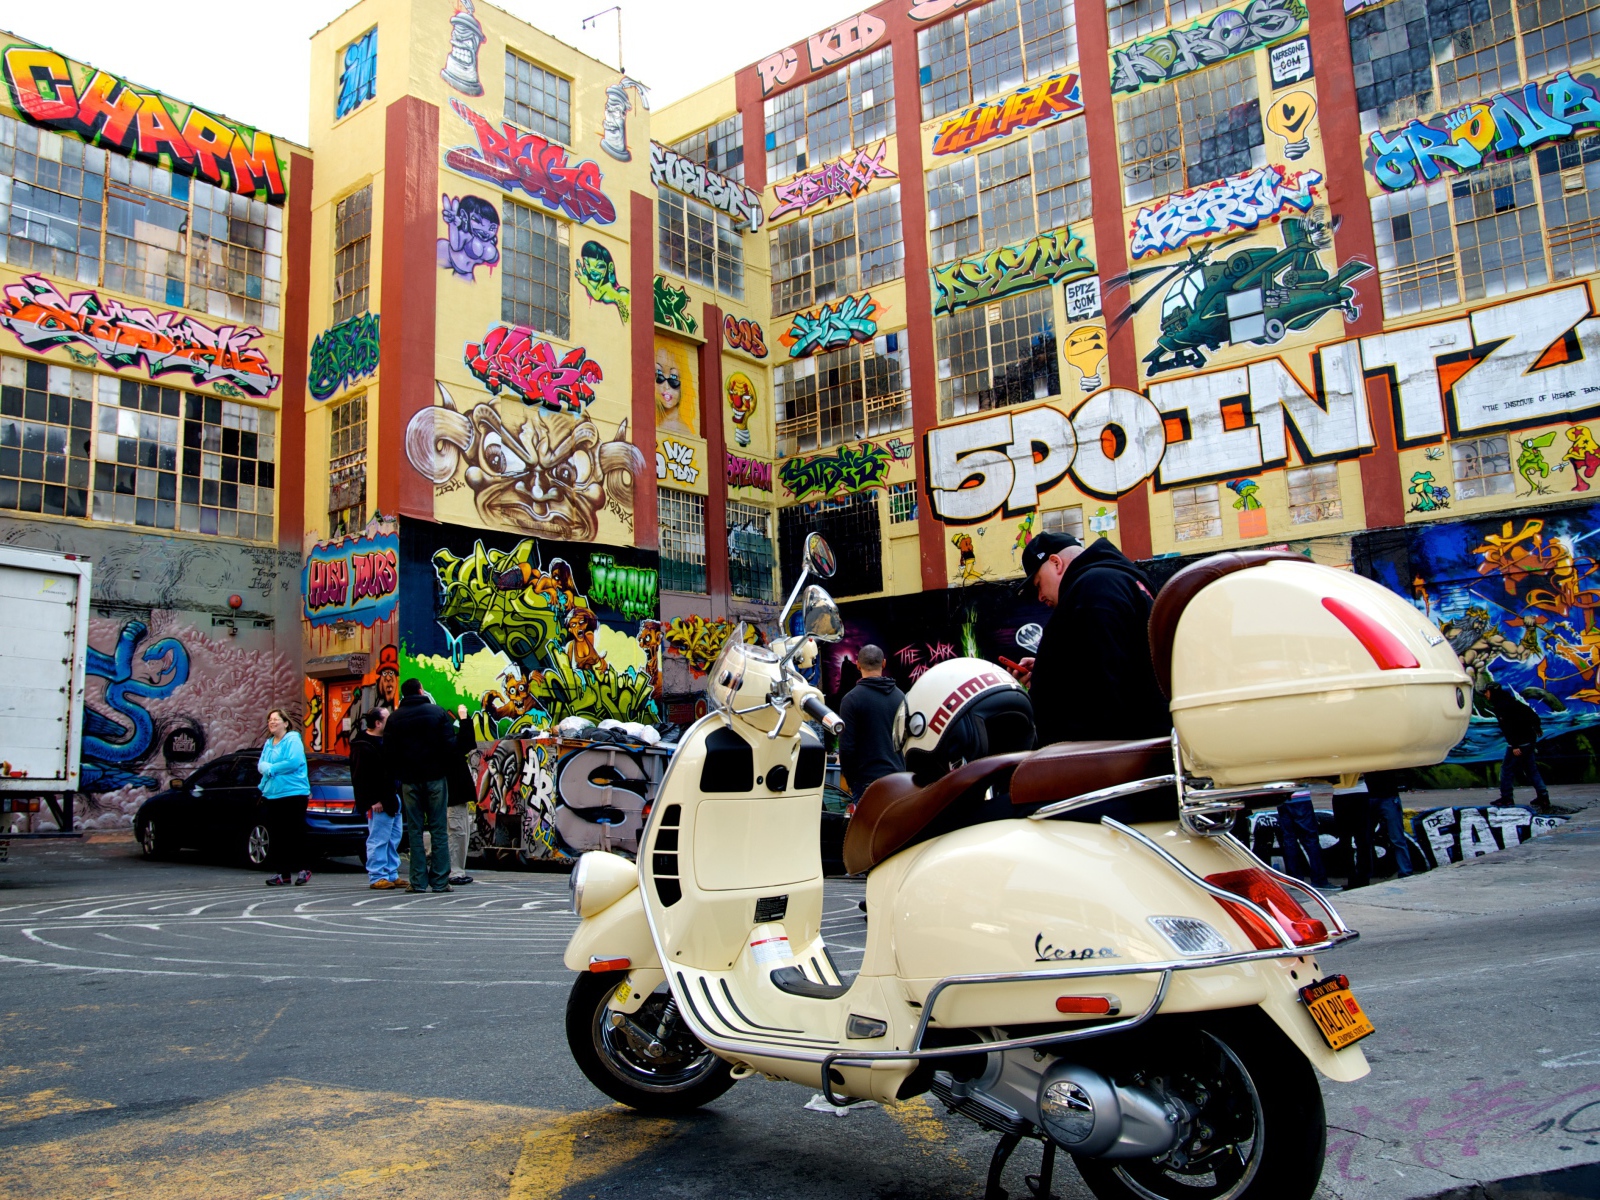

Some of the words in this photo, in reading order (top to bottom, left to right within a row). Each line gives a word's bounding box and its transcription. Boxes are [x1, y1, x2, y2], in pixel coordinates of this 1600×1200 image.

[757, 48, 798, 97] PC
[807, 12, 886, 72] KID
[3, 44, 286, 206] CHARM
[1121, 129, 1179, 163] LOOK
[1067, 281, 1096, 299] 5PTZ
[1073, 293, 1096, 311] .COM
[924, 280, 1600, 525] 5POINTZ
[1538, 394, 1547, 402] OF
[662, 440, 696, 466] NYC
[248, 577, 274, 598] Italy
[308, 558, 349, 612] HUSH
[351, 549, 398, 607] TOURS
[592, 566, 657, 606] DEADLY
[894, 642, 922, 666] THE
[925, 641, 958, 662] DARK
[1421, 805, 1535, 869] FAT
[1034, 931, 1123, 962] Vespa
[1337, 1031, 1356, 1044] EMPIRE
[1353, 1024, 1367, 1038] STATE
